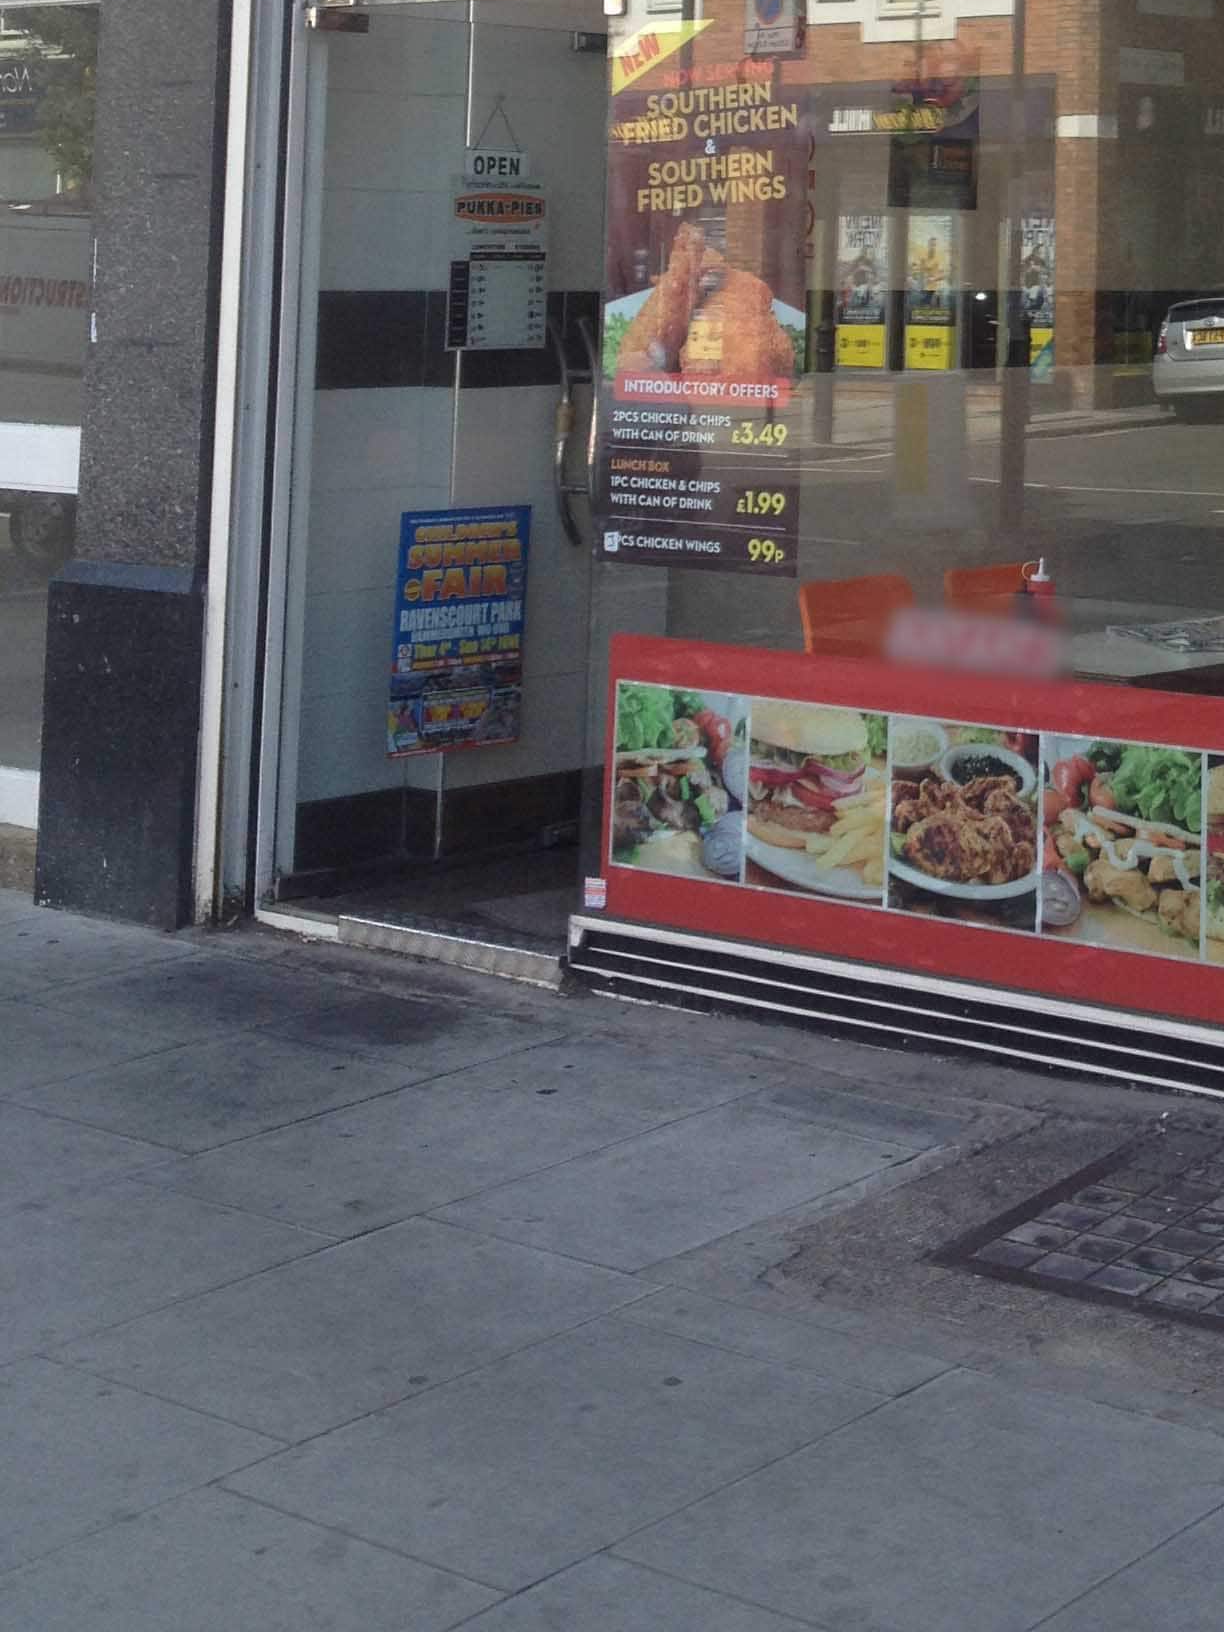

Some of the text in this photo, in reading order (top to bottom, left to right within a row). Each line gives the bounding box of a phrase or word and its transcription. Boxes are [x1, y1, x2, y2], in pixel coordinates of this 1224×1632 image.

[621, 32, 660, 77] NEW
[647, 81, 772, 117] SOUTHERN
[622, 104, 799, 145] FRIED CHICKEN
[704, 138, 716, 154] &
[473, 155, 520, 176] OPEN
[648, 150, 773, 186] SOUTHERN
[637, 176, 787, 213] FRIED WINGS
[456, 199, 542, 216] PUKKA-PIES
[624, 379, 779, 399] INTRODUCTORY OFFERS
[612, 410, 731, 428] 2PCS CHICKEN & CHIPS
[612, 428, 715, 444] WITH CAN OF DRINK
[731, 422, 788, 447] £3.49
[610, 475, 721, 494] 1PC CHICKEN & CHIPS
[610, 493, 713, 510] WITH CAN OF DRINK
[736, 491, 786, 515] £1.99
[407, 538, 521, 570] SUMMER
[636, 534, 683, 550] CHICKEN
[685, 538, 721, 553] WINGS
[748, 539, 784, 563] 99p
[421, 564, 508, 602] FAIR
[399, 603, 490, 633] RAVENSCOURT
